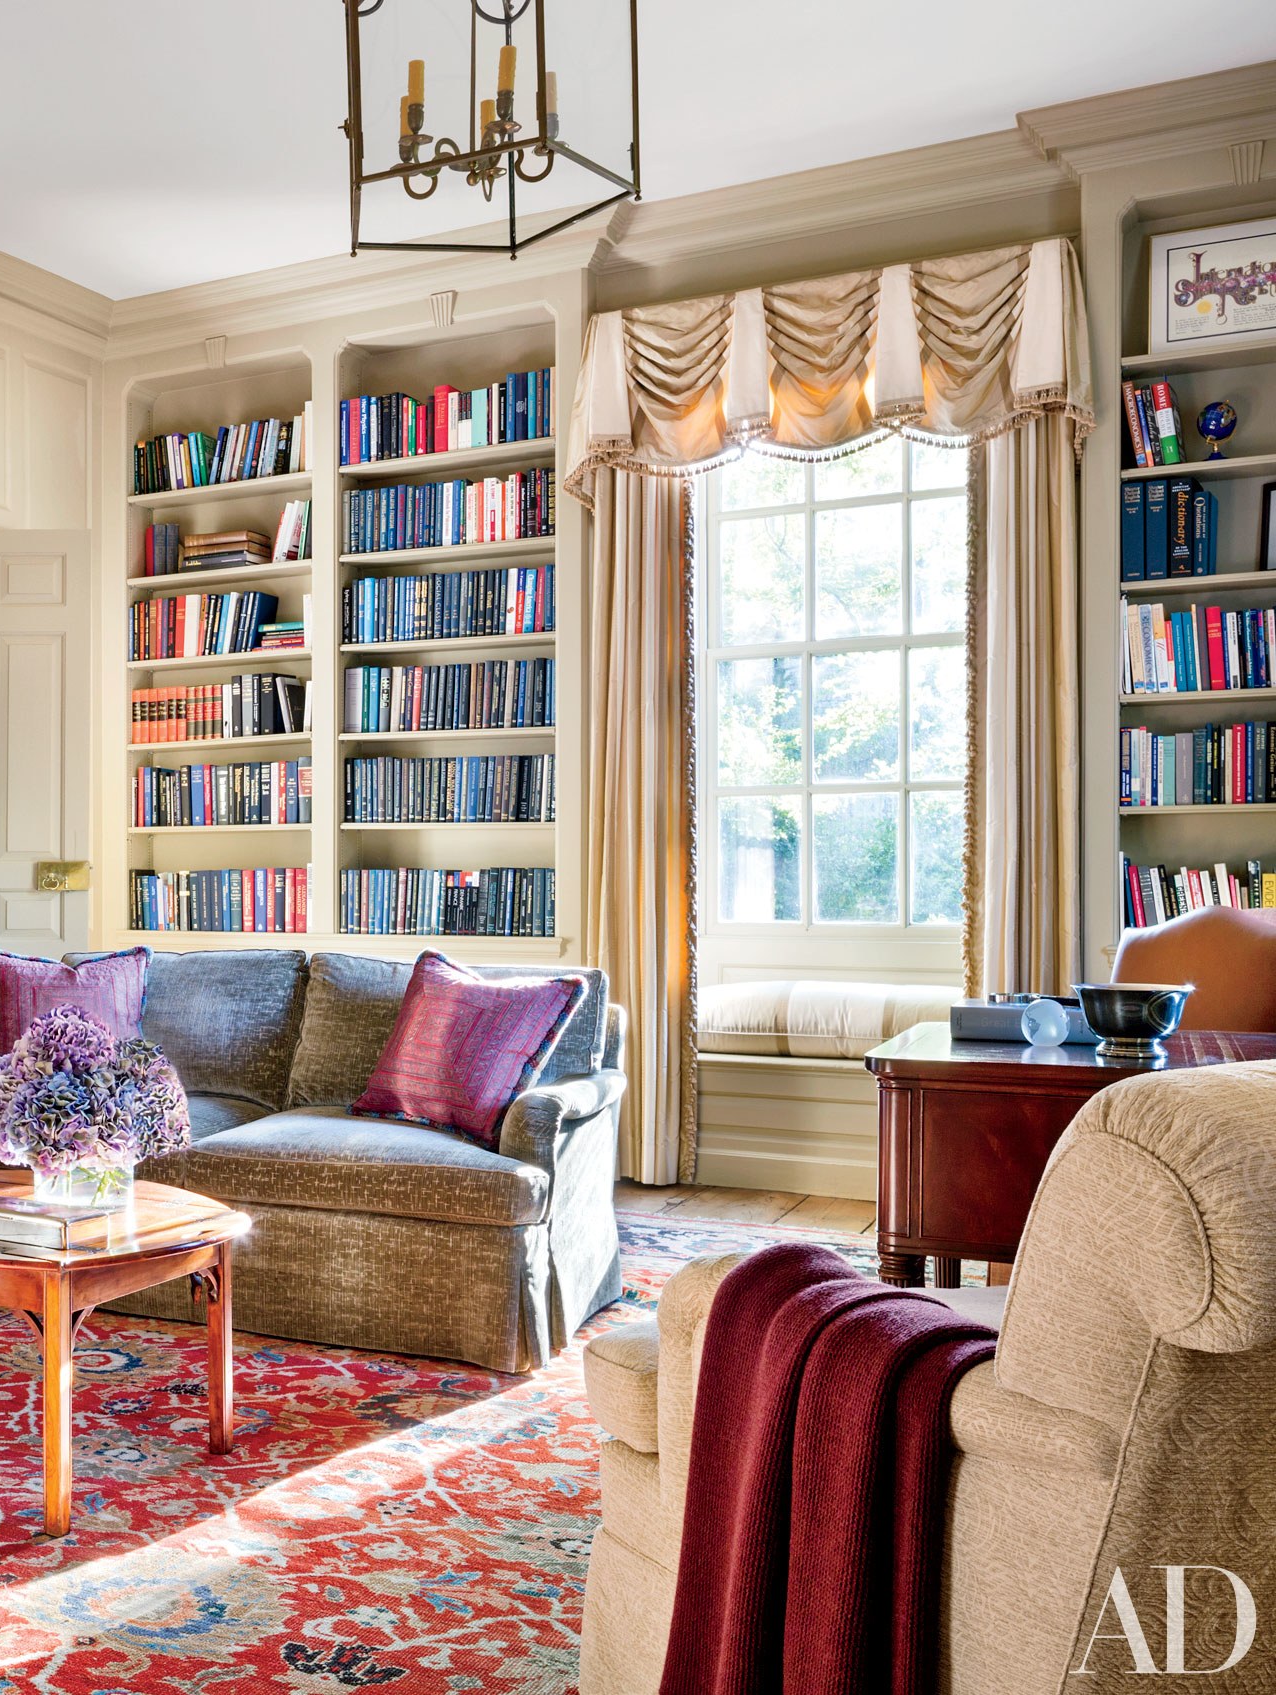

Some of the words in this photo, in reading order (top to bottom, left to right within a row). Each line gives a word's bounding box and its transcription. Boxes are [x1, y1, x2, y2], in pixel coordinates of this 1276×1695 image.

[1125, 387, 1142, 448] MACROECONOMICS
[1156, 384, 1167, 409] ROME
[1194, 497, 1206, 539] Quotations
[1142, 622, 1153, 673] ECONOMICS
